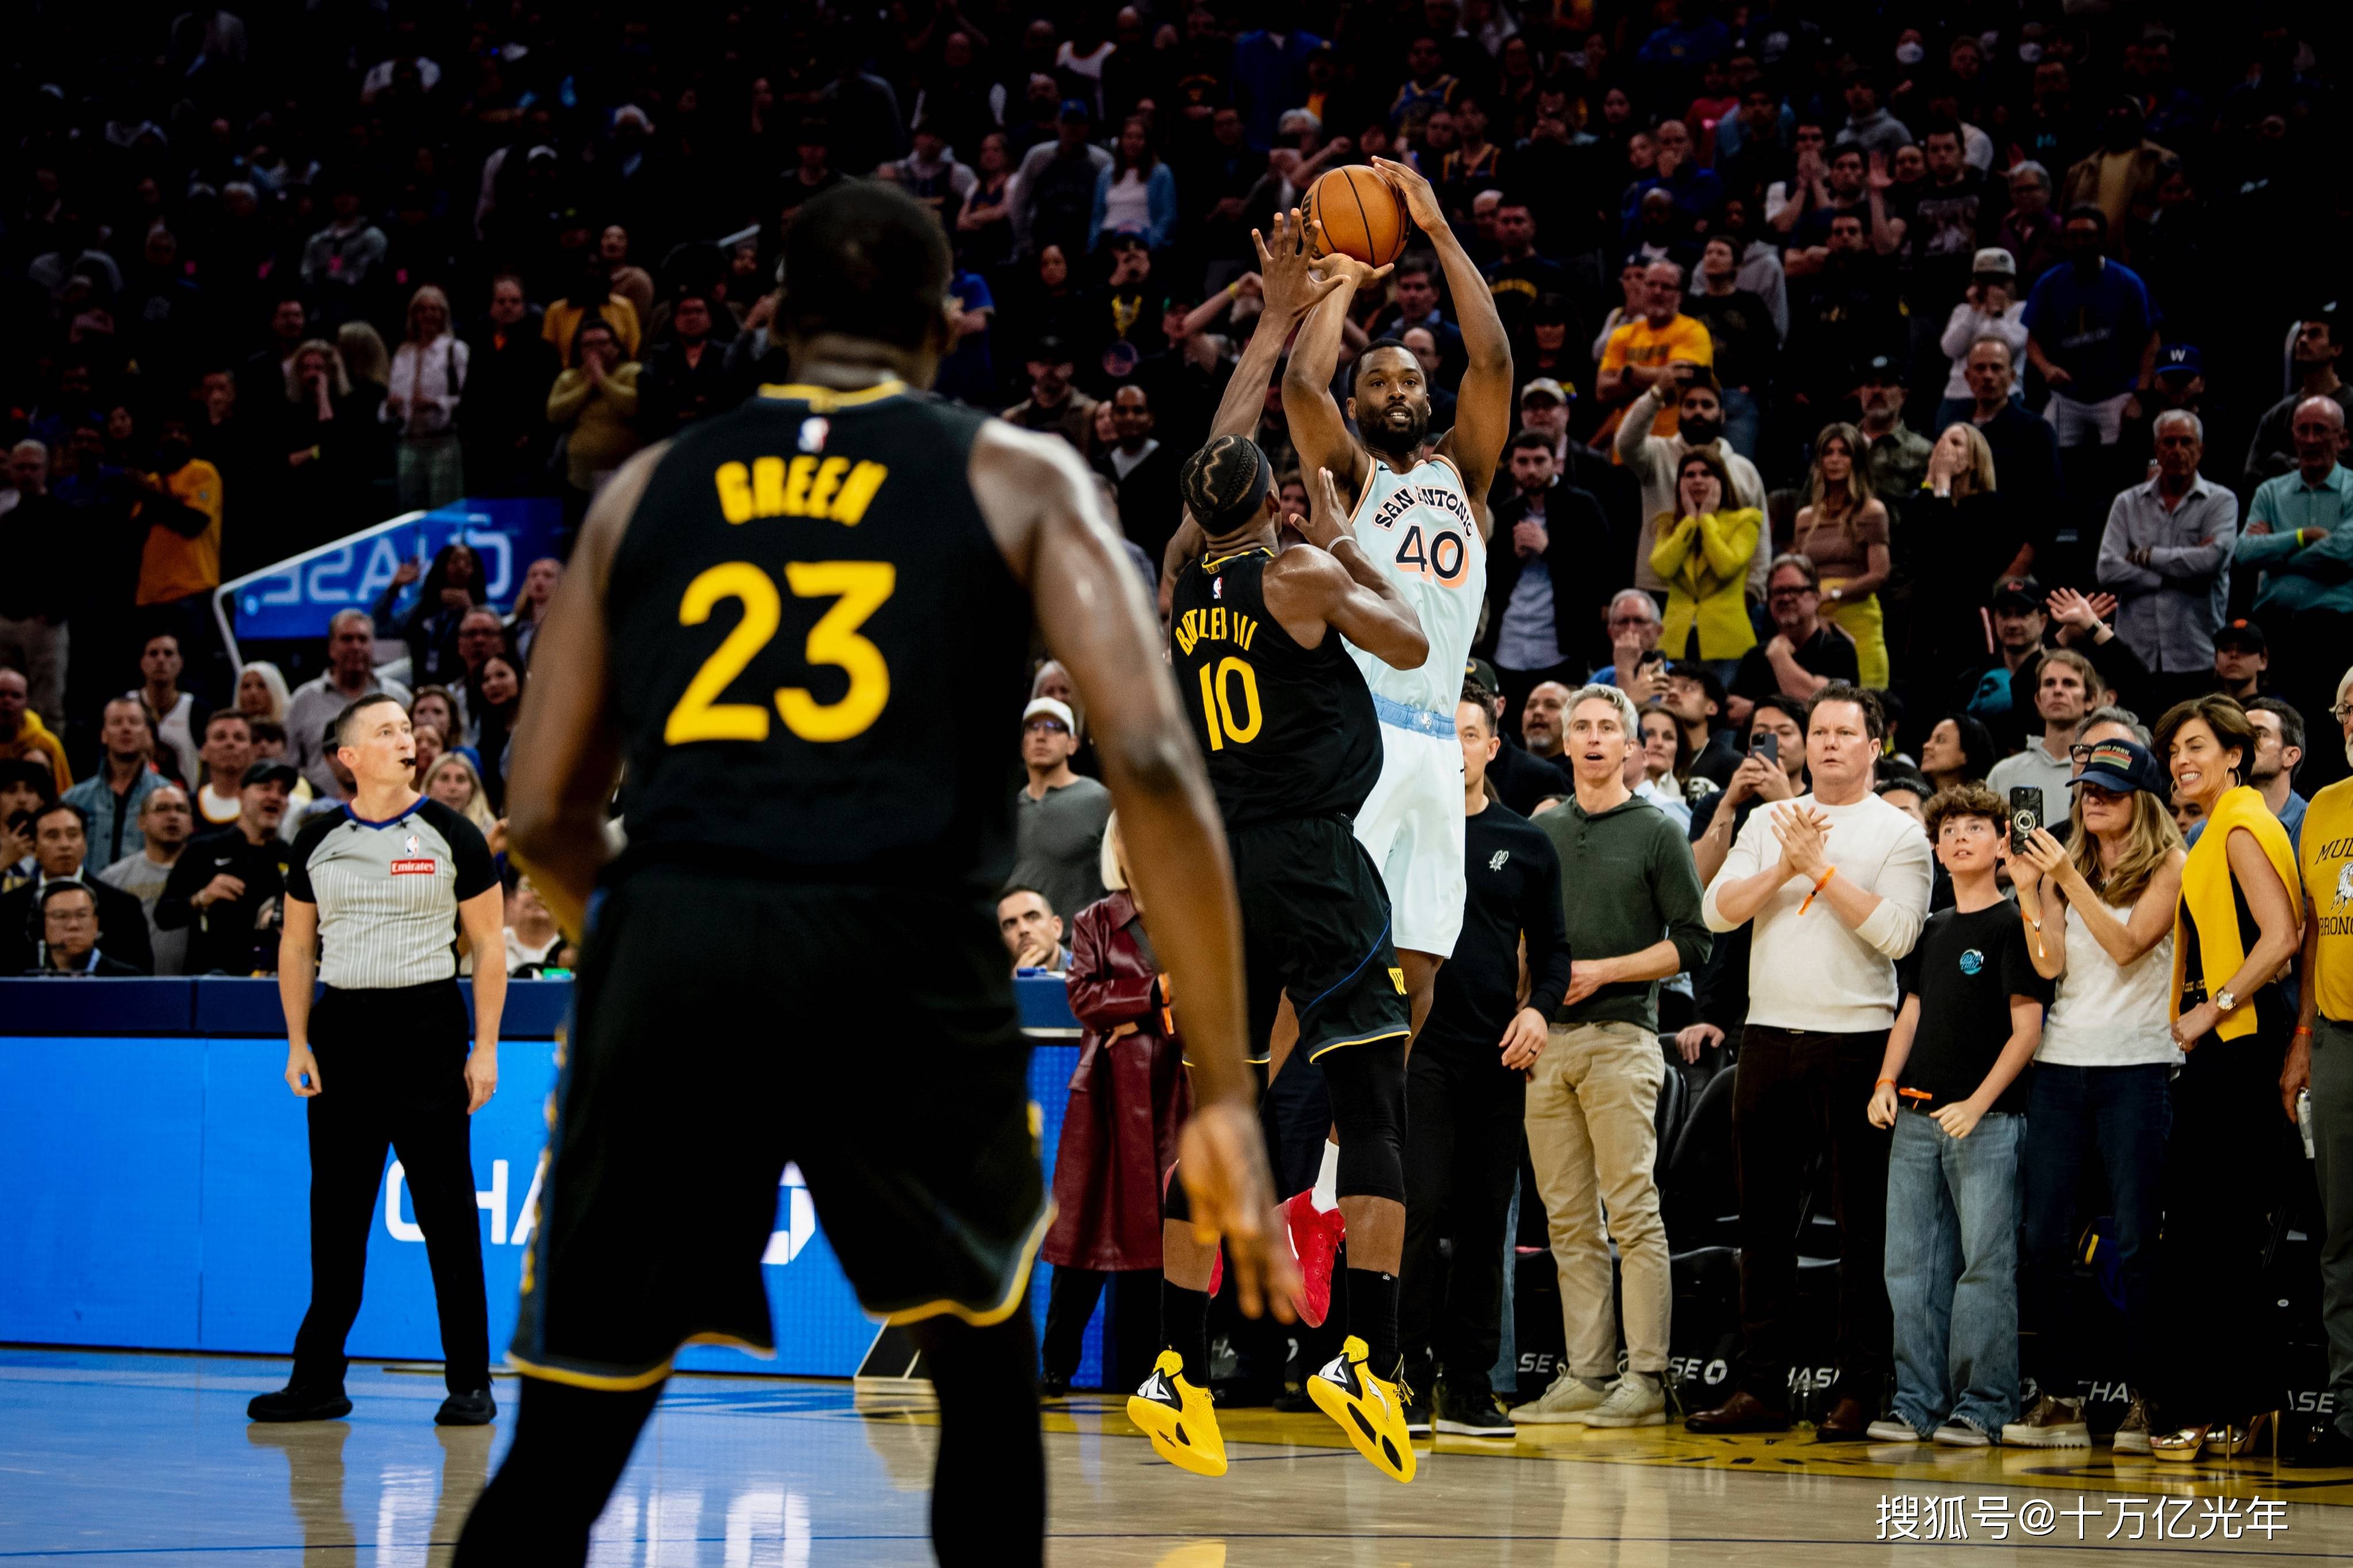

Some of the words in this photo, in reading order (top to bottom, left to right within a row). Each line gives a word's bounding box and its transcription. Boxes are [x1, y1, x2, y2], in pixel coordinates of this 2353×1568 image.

[2169, 349, 2186, 362] W
[714, 454, 889, 527] GREEN
[1375, 488, 1415, 528] SAN
[1396, 525, 1465, 580] 40
[663, 559, 897, 747] 23
[1175, 607, 1228, 656] BUTLER
[1233, 611, 1259, 651] III
[1199, 655, 1263, 751] 10
[392, 861, 434, 873] Emirates
